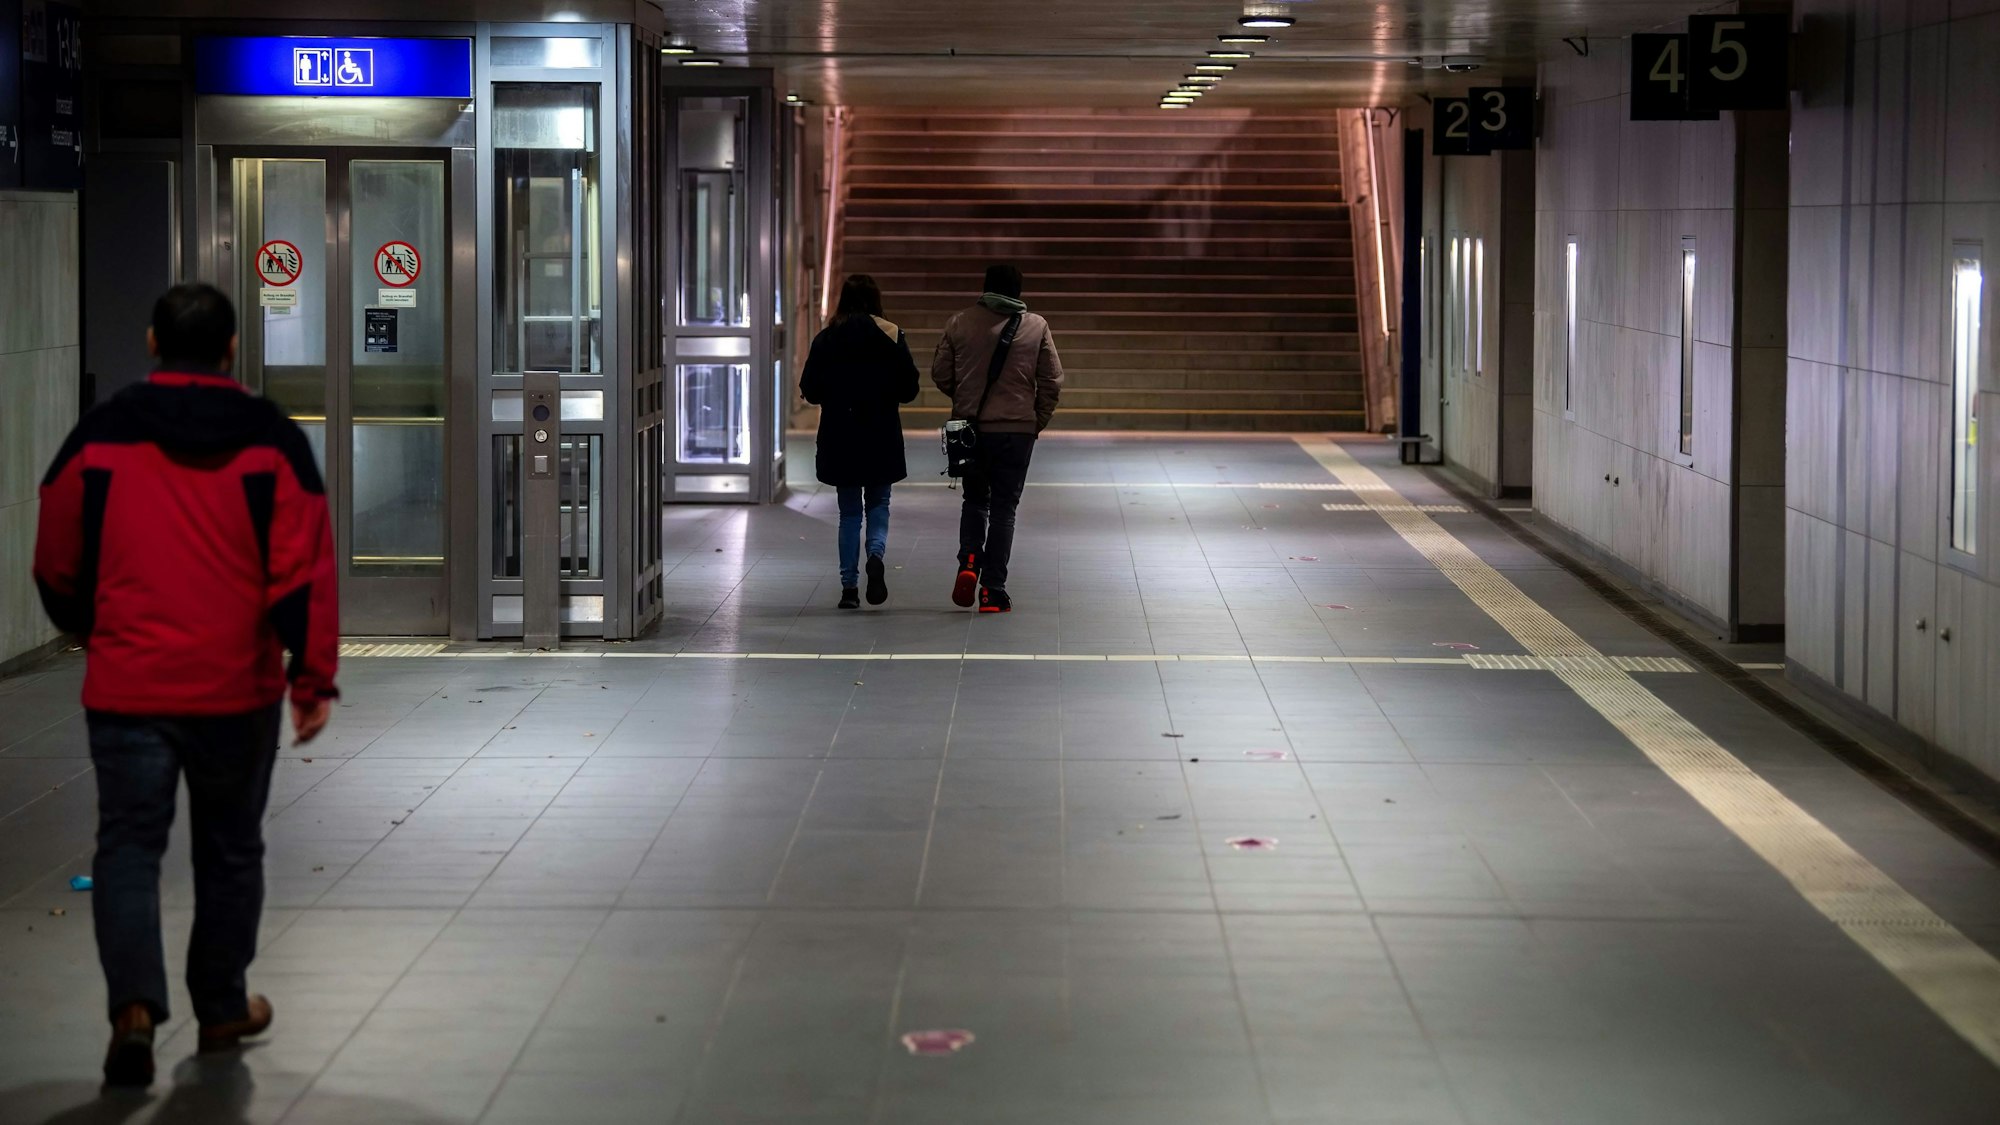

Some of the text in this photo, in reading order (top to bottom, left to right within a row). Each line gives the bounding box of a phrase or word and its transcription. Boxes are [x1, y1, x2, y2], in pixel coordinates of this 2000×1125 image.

[1649, 39, 1685, 93] 4
[1709, 21, 1748, 81] 5
[1445, 102, 1469, 138] 2
[1481, 91, 1507, 131] 3
